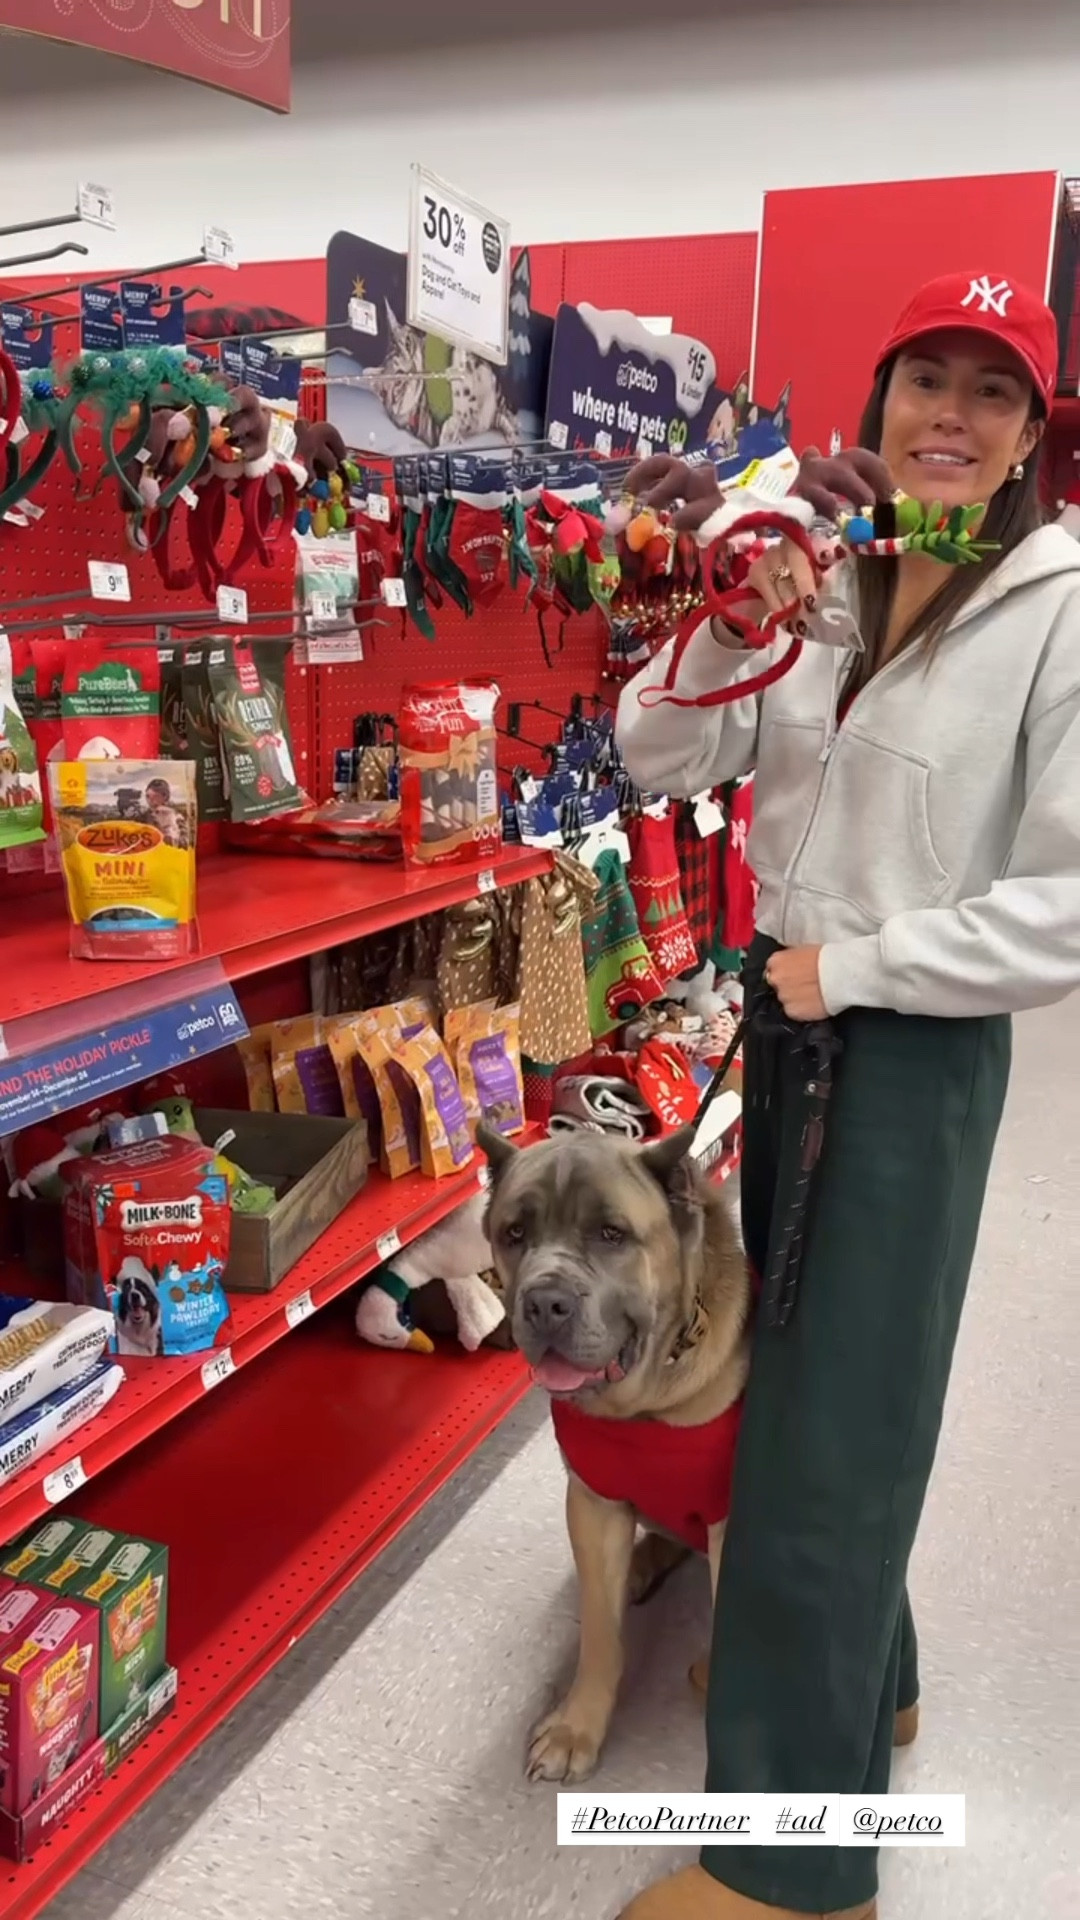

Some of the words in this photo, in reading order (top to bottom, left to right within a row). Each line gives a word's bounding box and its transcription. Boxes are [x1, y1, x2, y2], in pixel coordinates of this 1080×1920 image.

[453, 241, 465, 257] off
[421, 264, 435, 281] Dog
[435, 271, 447, 287] and
[470, 291, 481, 304] and
[421, 280, 445, 300] Apparel
[124, 291, 149, 300] MERRY
[628, 365, 658, 393] petco
[572, 386, 616, 426] where
[617, 400, 638, 434] the
[640, 415, 666, 443] pets
[668, 418, 688, 444] GO
[78, 677, 128, 691] PureBites
[438, 715, 465, 734] Fun
[94, 860, 145, 877] MINI
[186, 1015, 215, 1037] petco
[23, 1064, 52, 1085] THE
[52, 1043, 107, 1076] HOLIDAY
[108, 1028, 152, 1056] PICKLE
[123, 1234, 150, 1246] Soft
[157, 1231, 202, 1245] Chewy
[175, 1295, 215, 1313] WINTER
[41, 1764, 94, 1827] NAUGHTY
